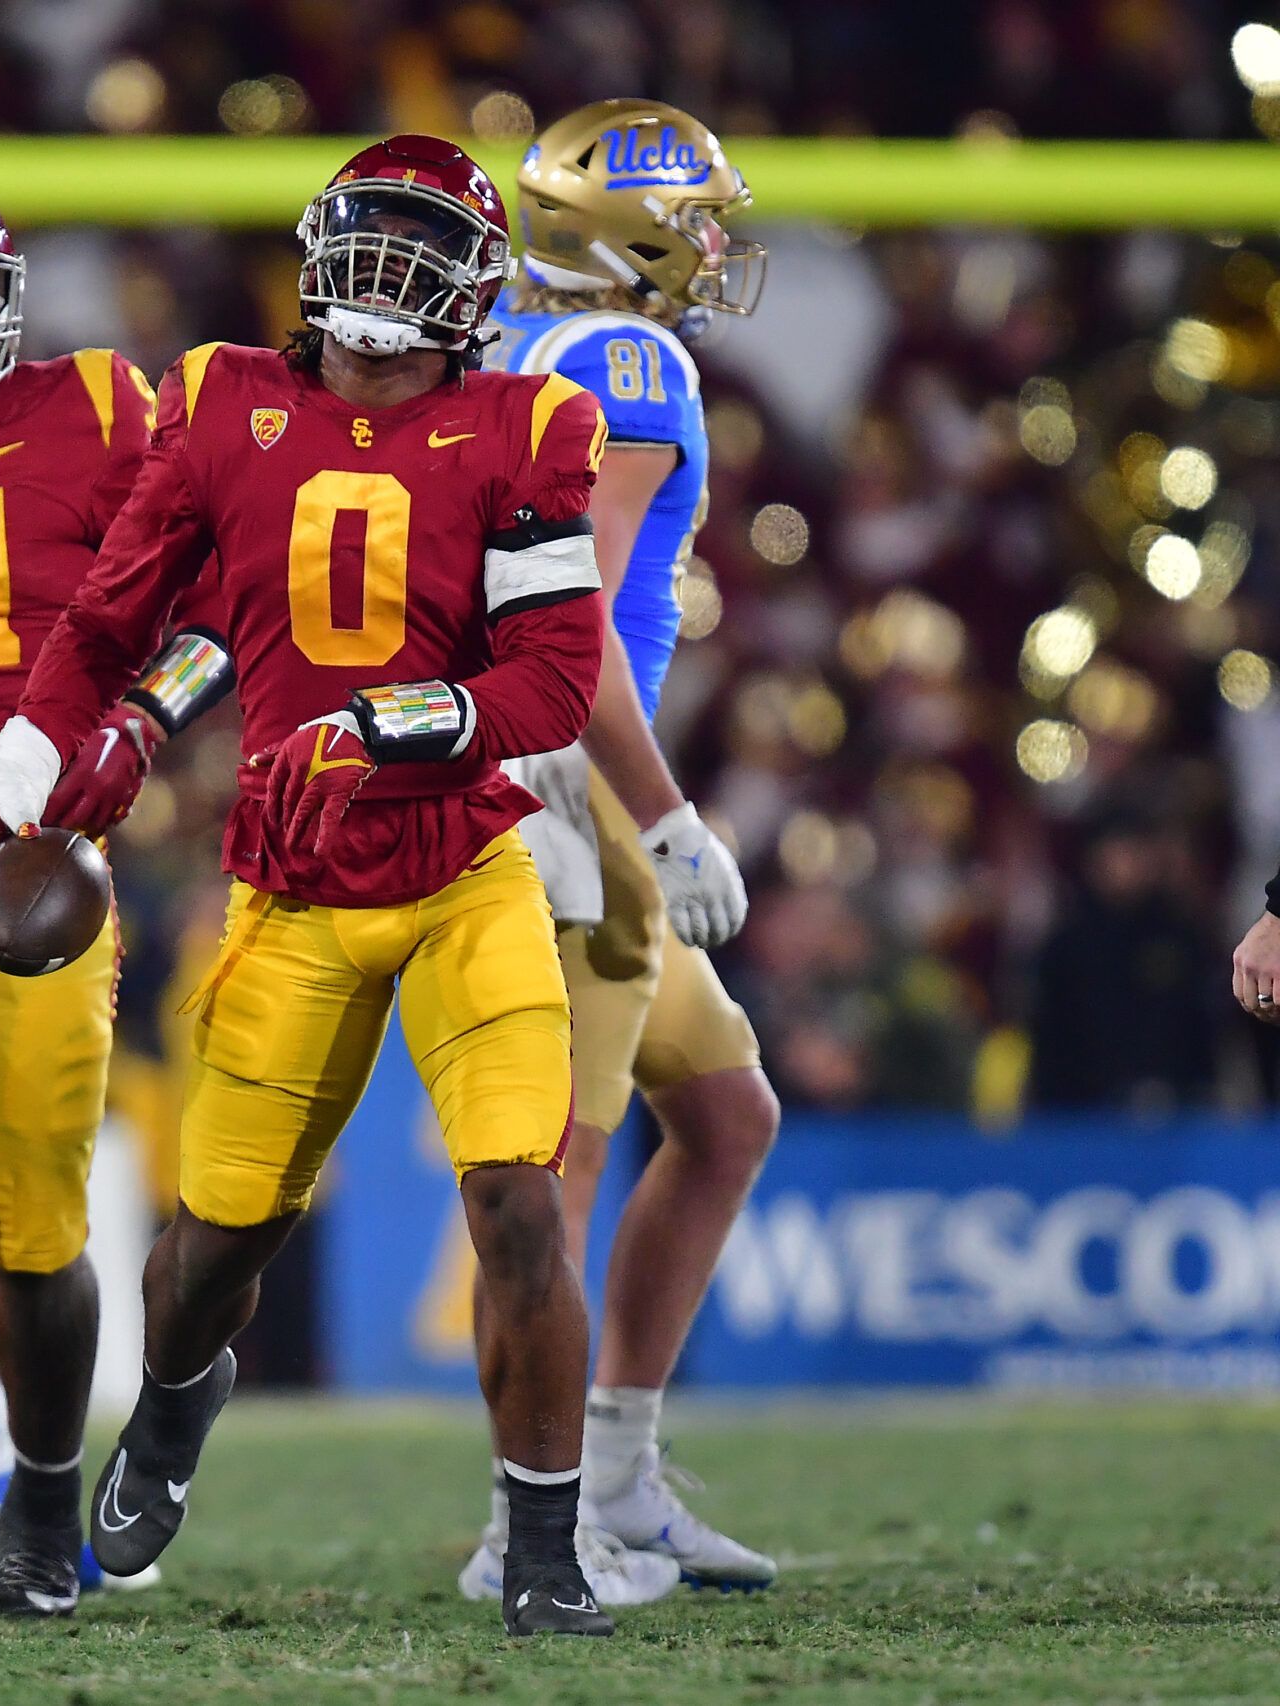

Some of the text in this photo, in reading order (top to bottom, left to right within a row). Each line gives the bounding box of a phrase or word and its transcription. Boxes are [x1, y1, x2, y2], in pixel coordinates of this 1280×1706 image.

[605, 338, 667, 403] 81
[258, 425, 276, 440] 12
[288, 469, 411, 666] 0
[715, 1184, 1280, 1340] WESCO
